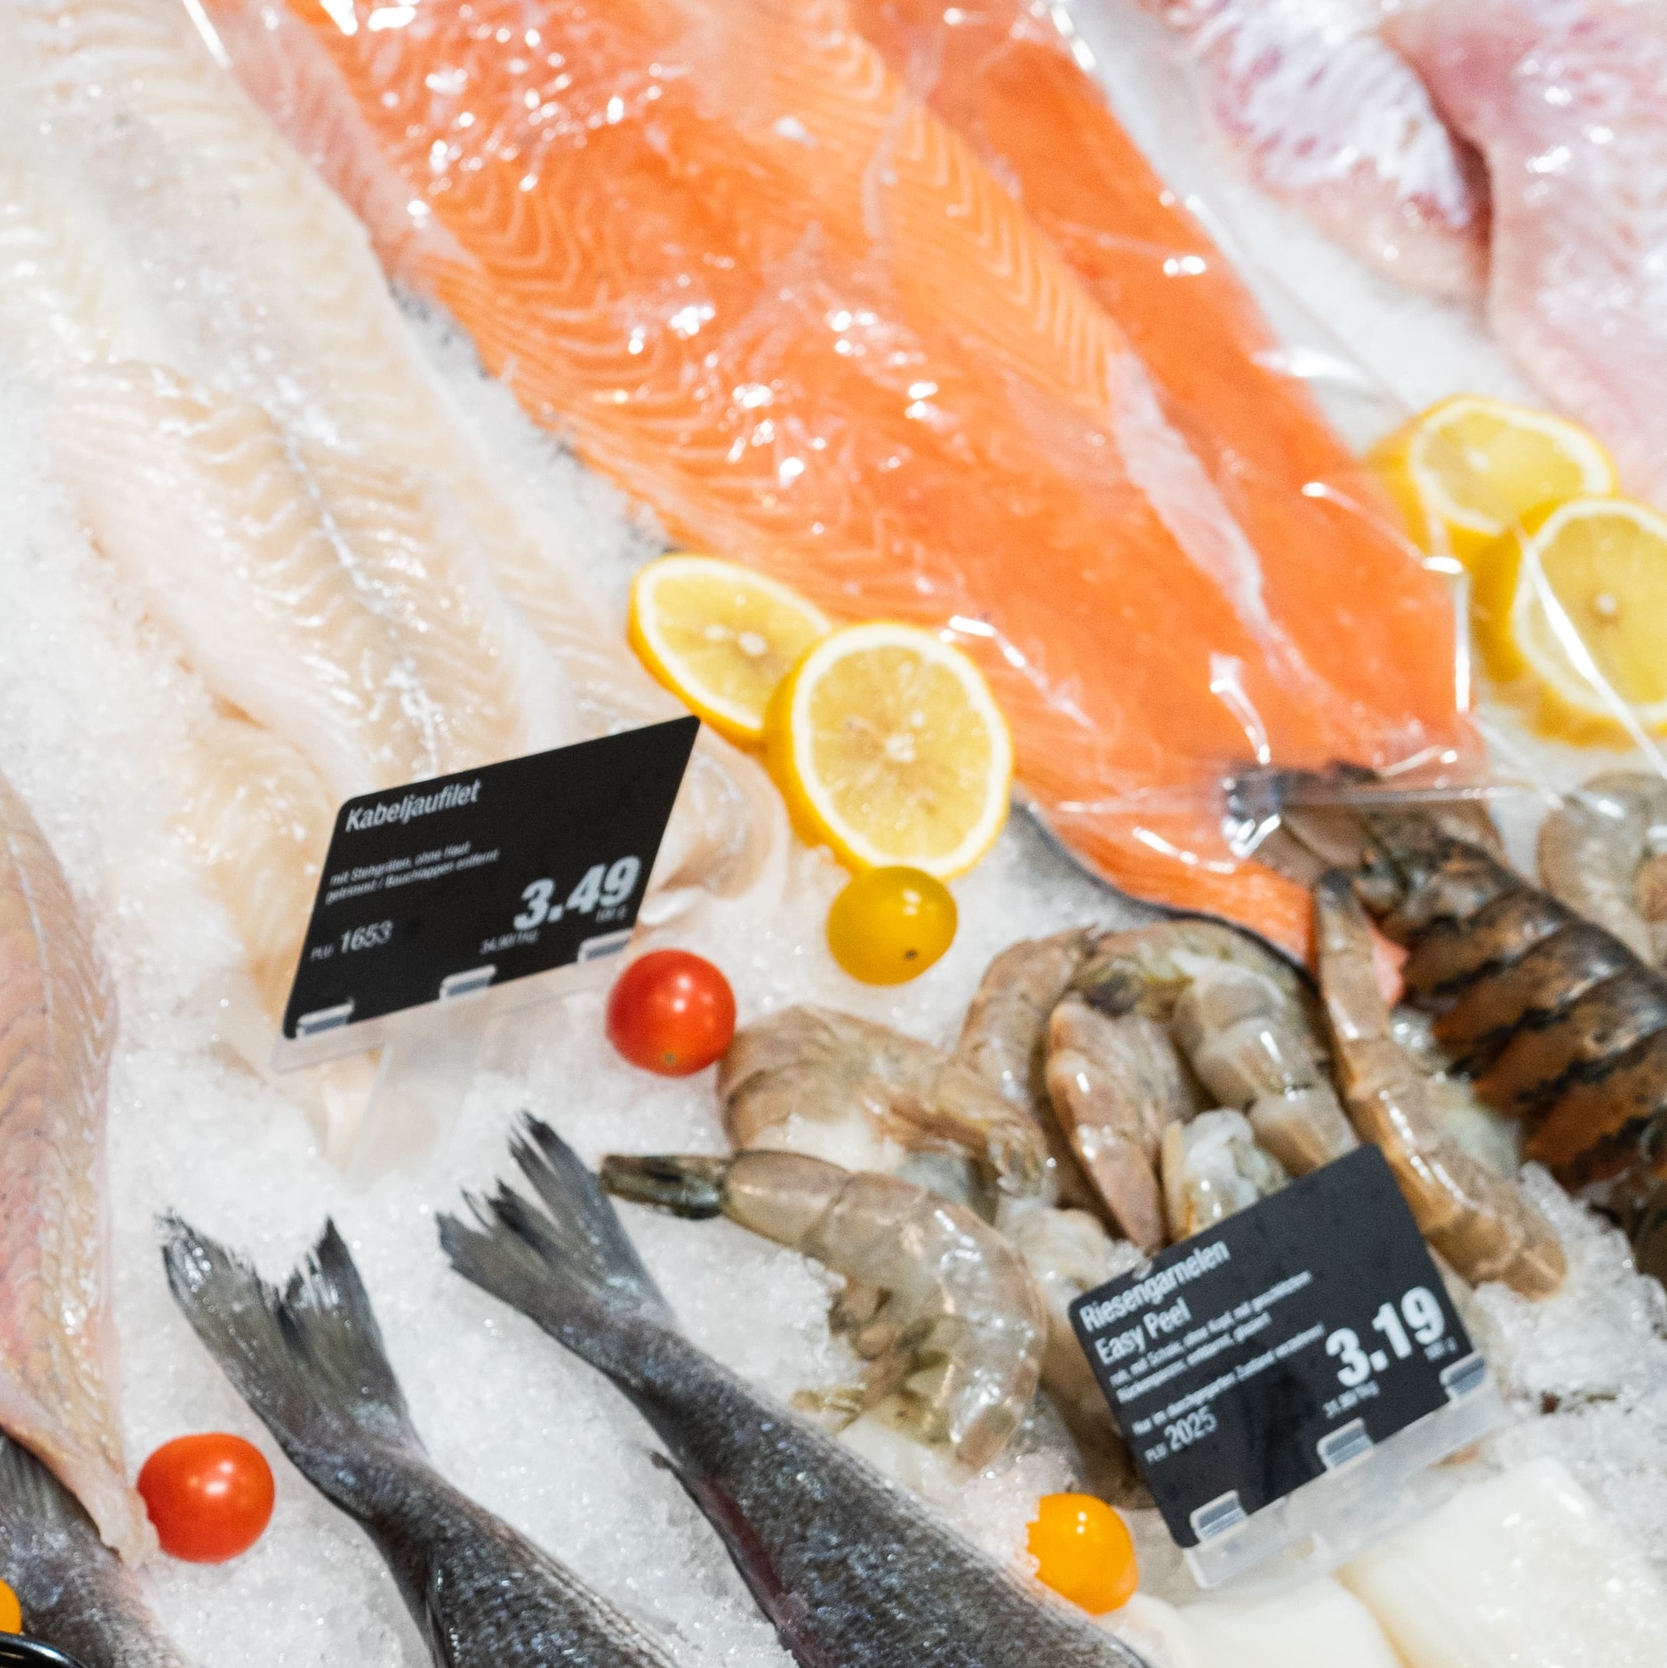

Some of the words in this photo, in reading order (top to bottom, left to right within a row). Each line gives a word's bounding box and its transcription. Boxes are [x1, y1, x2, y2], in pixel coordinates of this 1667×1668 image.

[346, 780, 481, 832] Kabeljaufilet
[514, 856, 640, 930] 3.49
[342, 921, 393, 952] 1653
[1080, 1241, 1230, 1332] Riesengarnelen
[1095, 1326, 1145, 1365] Easy
[1143, 1297, 1191, 1338] Peel
[1326, 1287, 1444, 1389] 3.19
[1164, 1405, 1216, 1450] 2025
